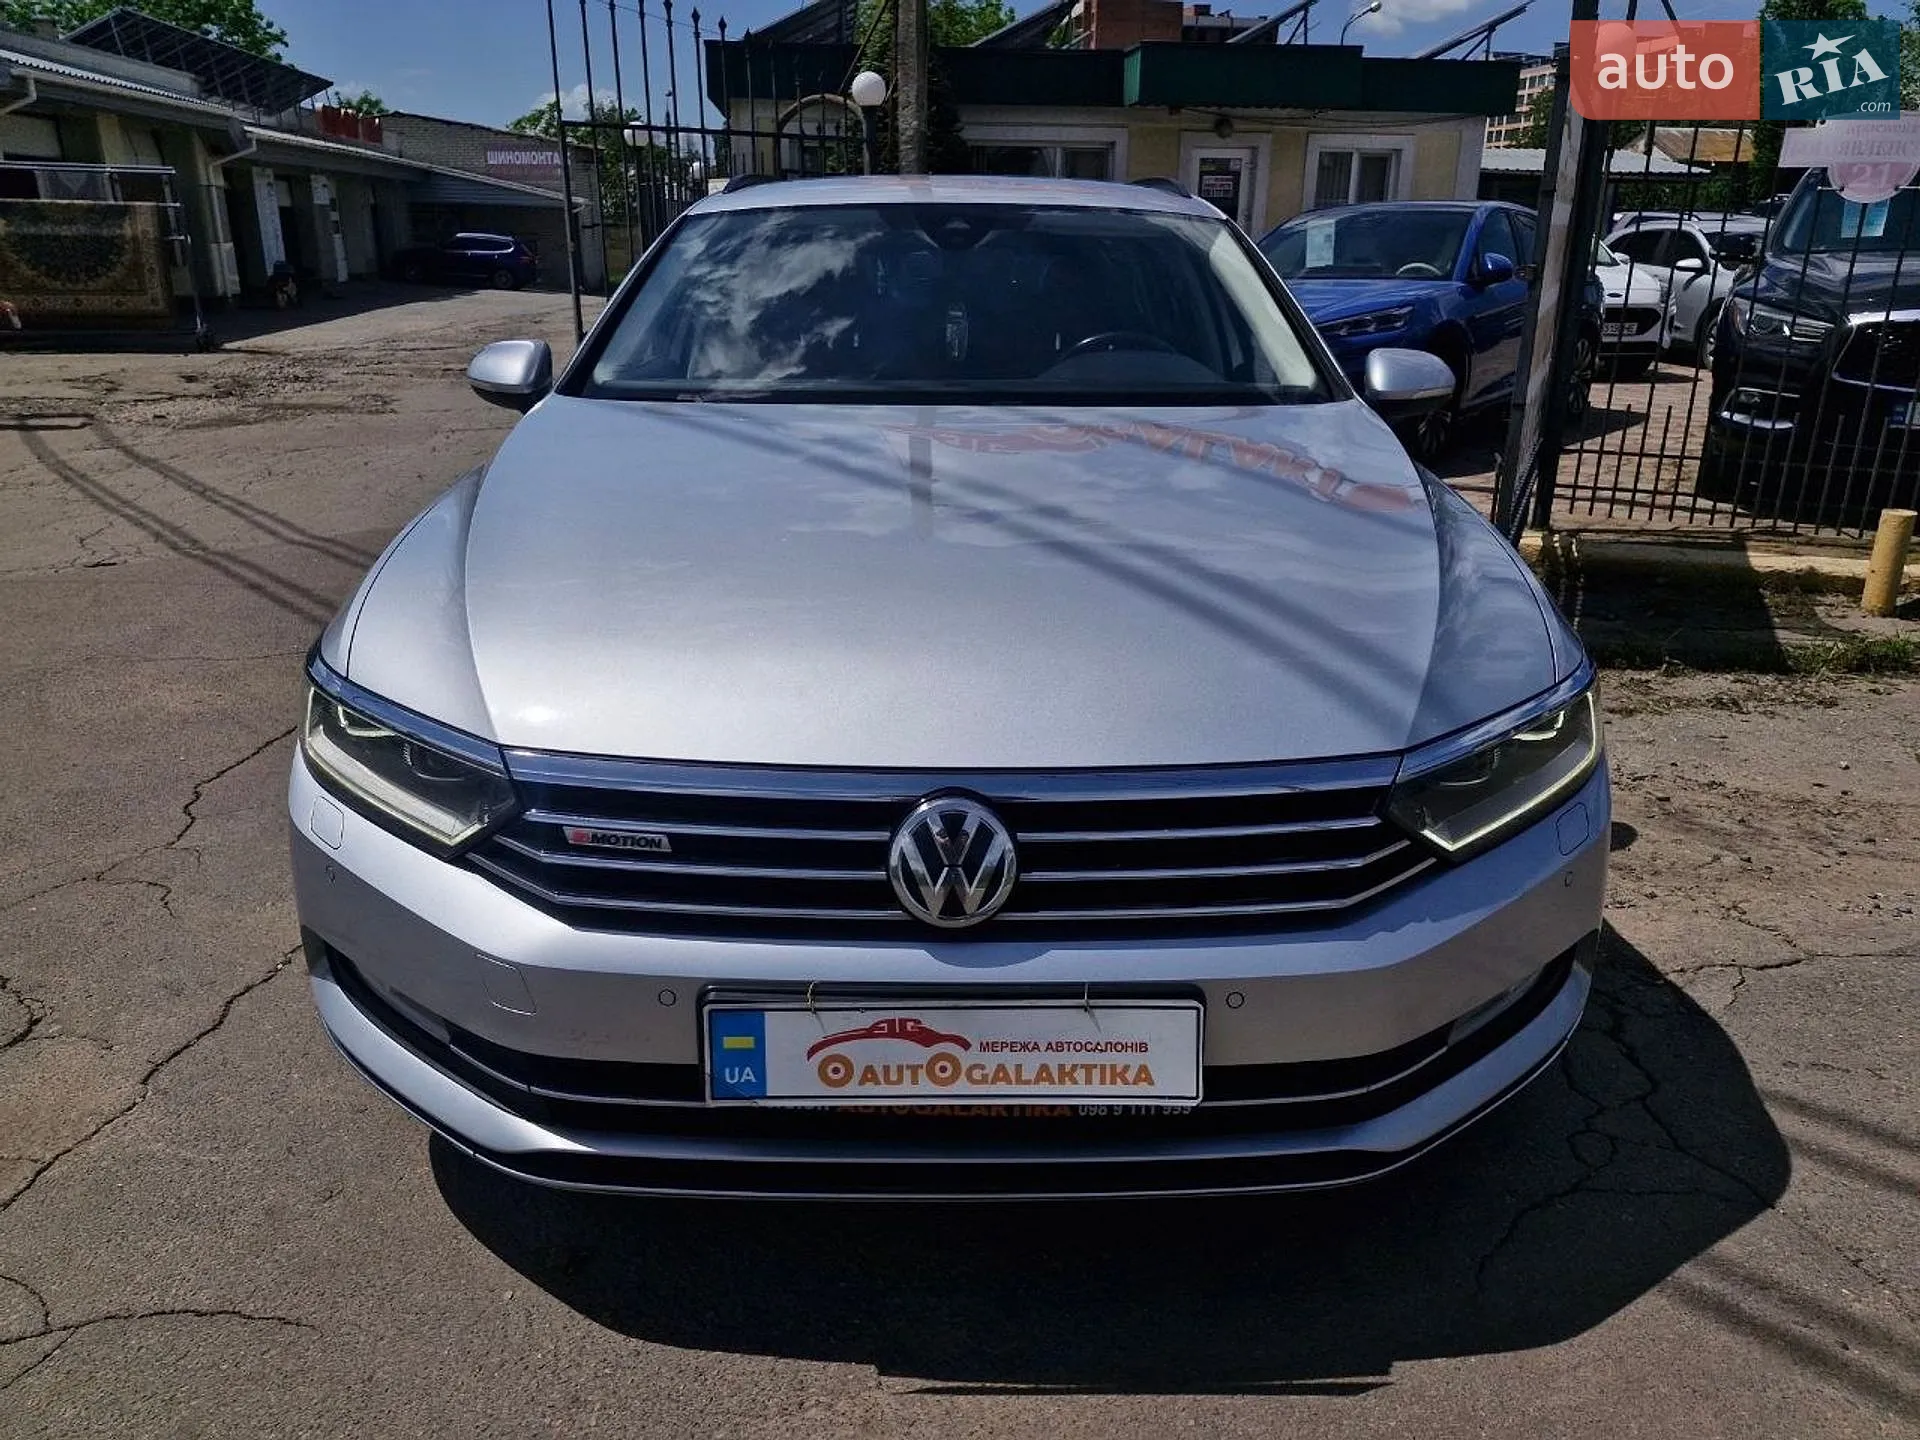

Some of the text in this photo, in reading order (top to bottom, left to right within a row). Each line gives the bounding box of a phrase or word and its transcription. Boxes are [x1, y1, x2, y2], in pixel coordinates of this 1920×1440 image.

[487, 150, 570, 165] ШИНОМОНТА
[1852, 162, 1891, 188] 21
[979, 1041, 1149, 1053] МЕРЕЖА АВТОСАЛОНІВ
[724, 1067, 757, 1084] UA
